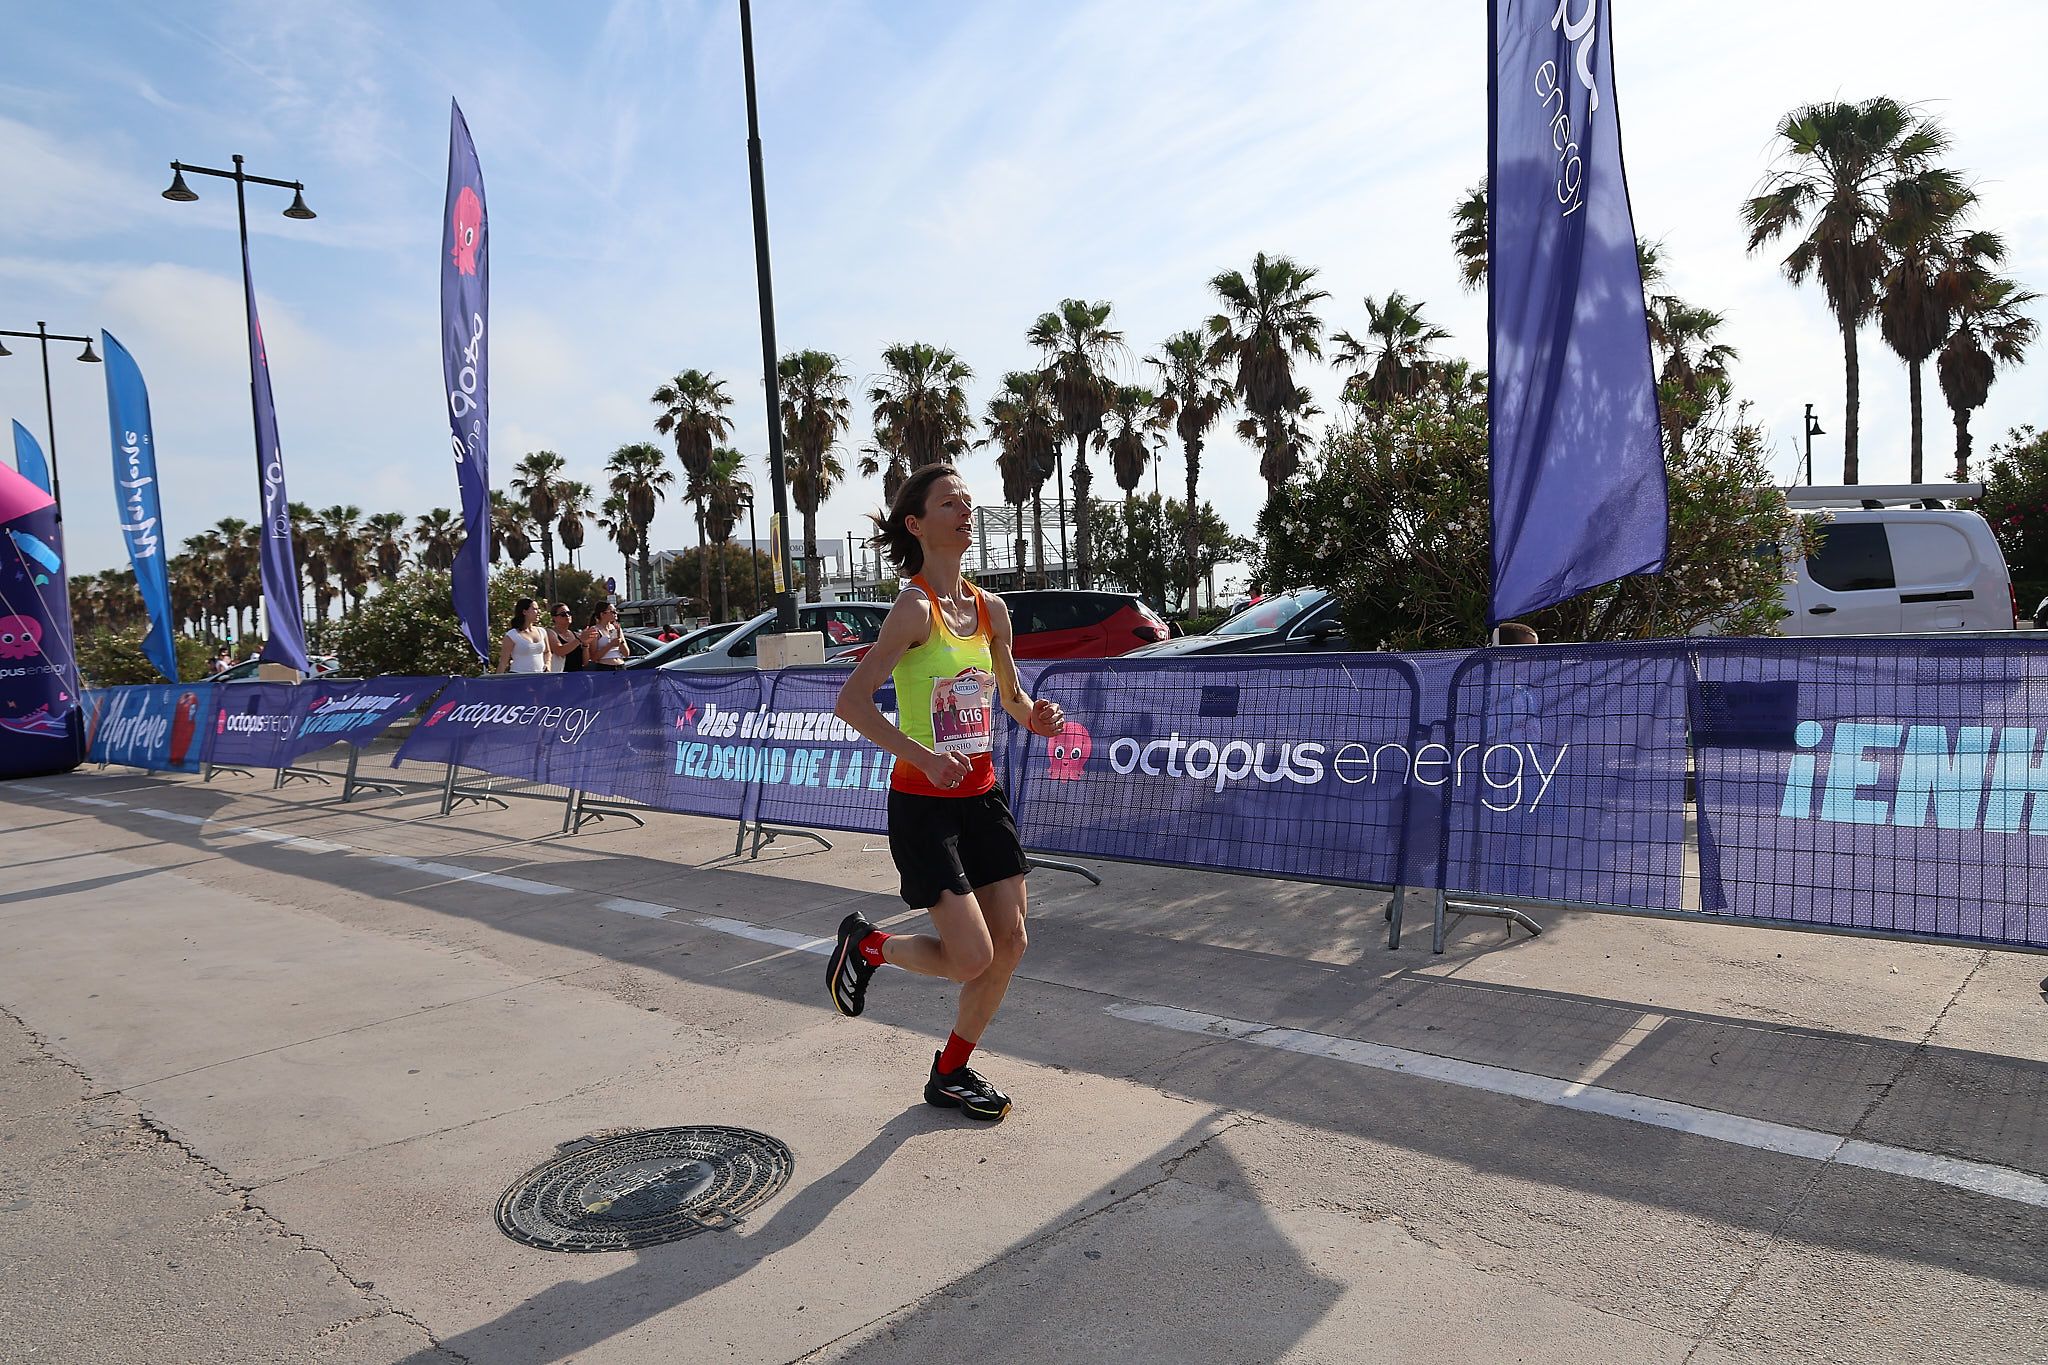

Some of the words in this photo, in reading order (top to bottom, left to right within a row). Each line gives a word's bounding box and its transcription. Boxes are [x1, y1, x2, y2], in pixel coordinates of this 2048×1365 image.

[1535, 60, 1583, 217] energy
[227, 712, 264, 737] octopus
[448, 702, 525, 728] octopus
[519, 706, 600, 744] energy
[697, 703, 740, 738] Has
[960, 708, 982, 723] 016
[674, 741, 786, 785] VELOCIDAD
[789, 748, 825, 788] DE
[827, 750, 862, 790] LA
[945, 742, 971, 752] OYSHO
[1108, 732, 1325, 793] octopus
[1334, 742, 1569, 813] energy
